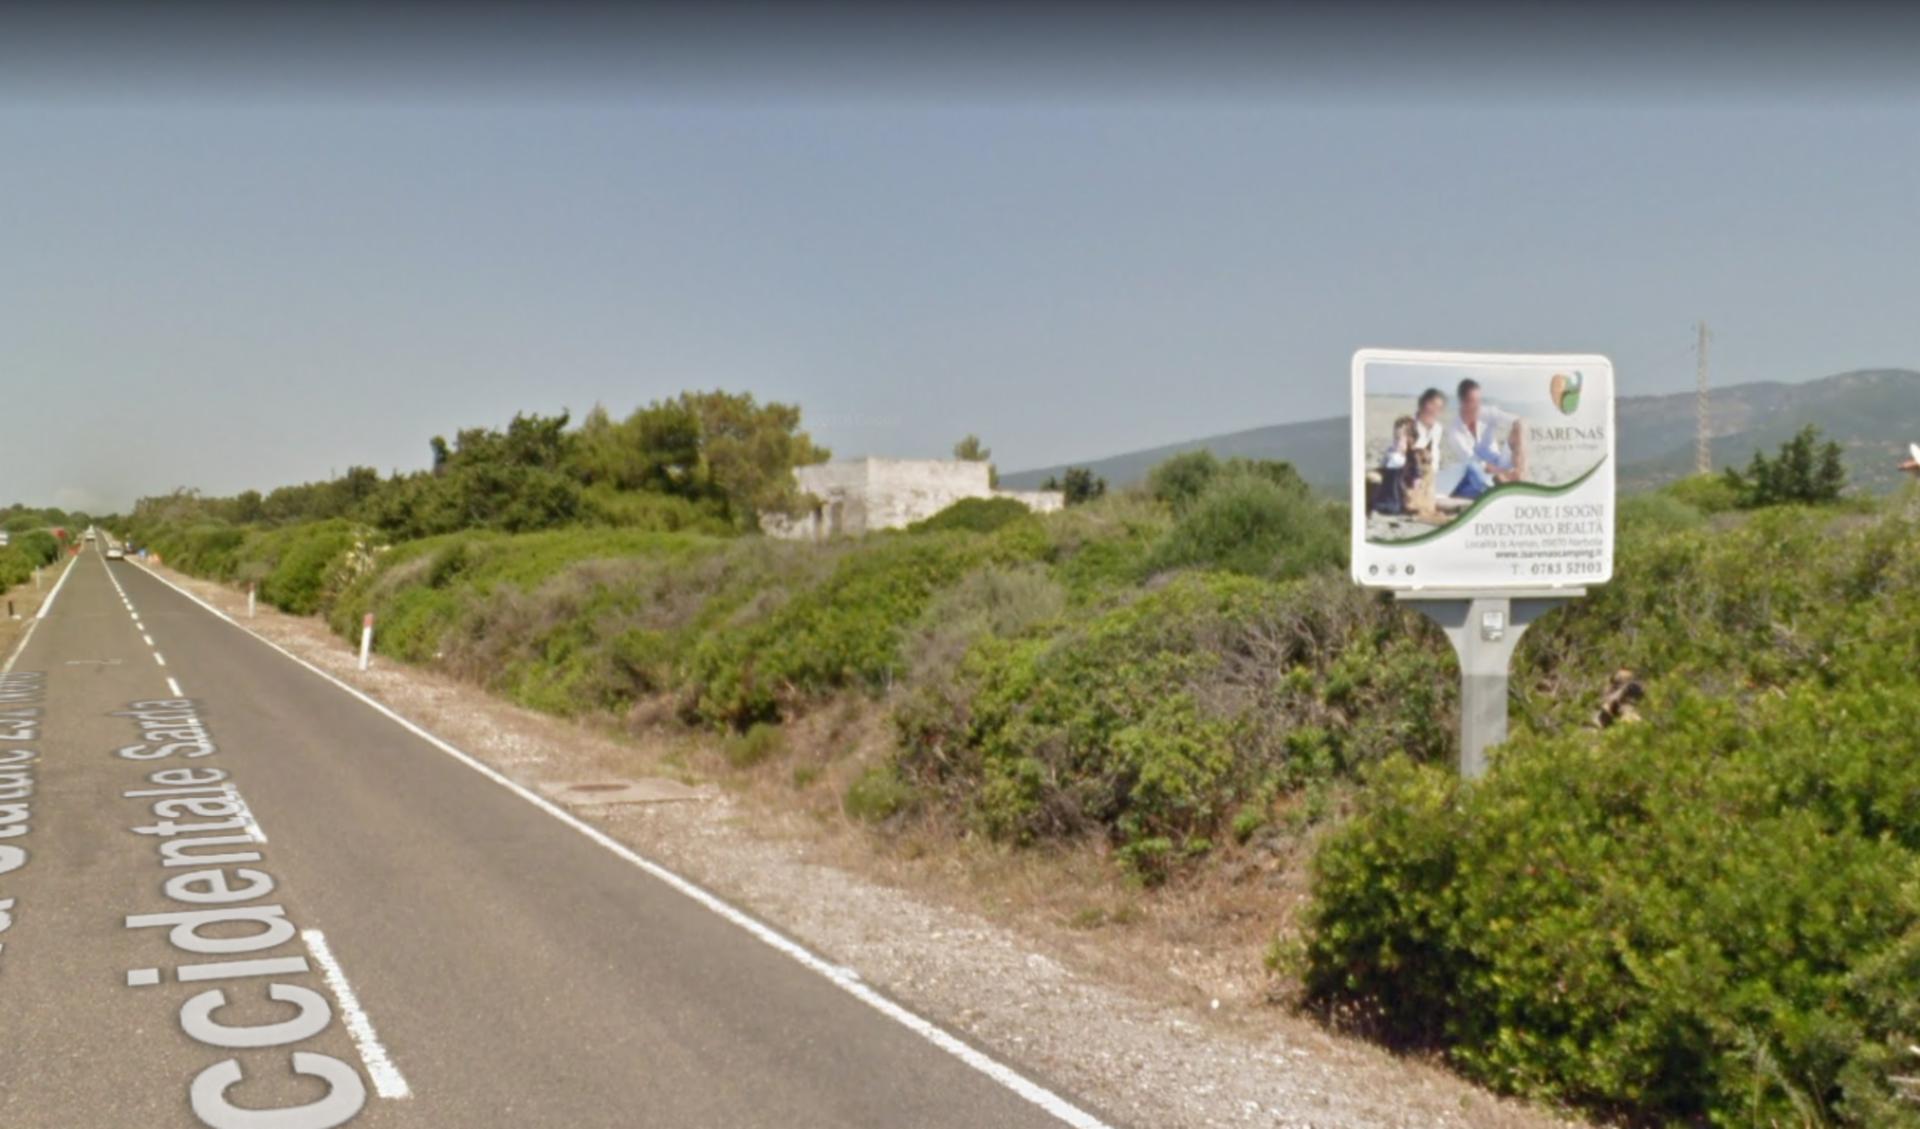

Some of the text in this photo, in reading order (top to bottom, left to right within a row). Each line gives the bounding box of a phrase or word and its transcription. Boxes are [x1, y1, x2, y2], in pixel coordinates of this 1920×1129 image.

[1530, 427, 1604, 441] ISARENAS
[1515, 505, 1552, 519] DOVE
[1563, 503, 1604, 518] SOGNI
[1475, 522, 1554, 536] DIVENTANO
